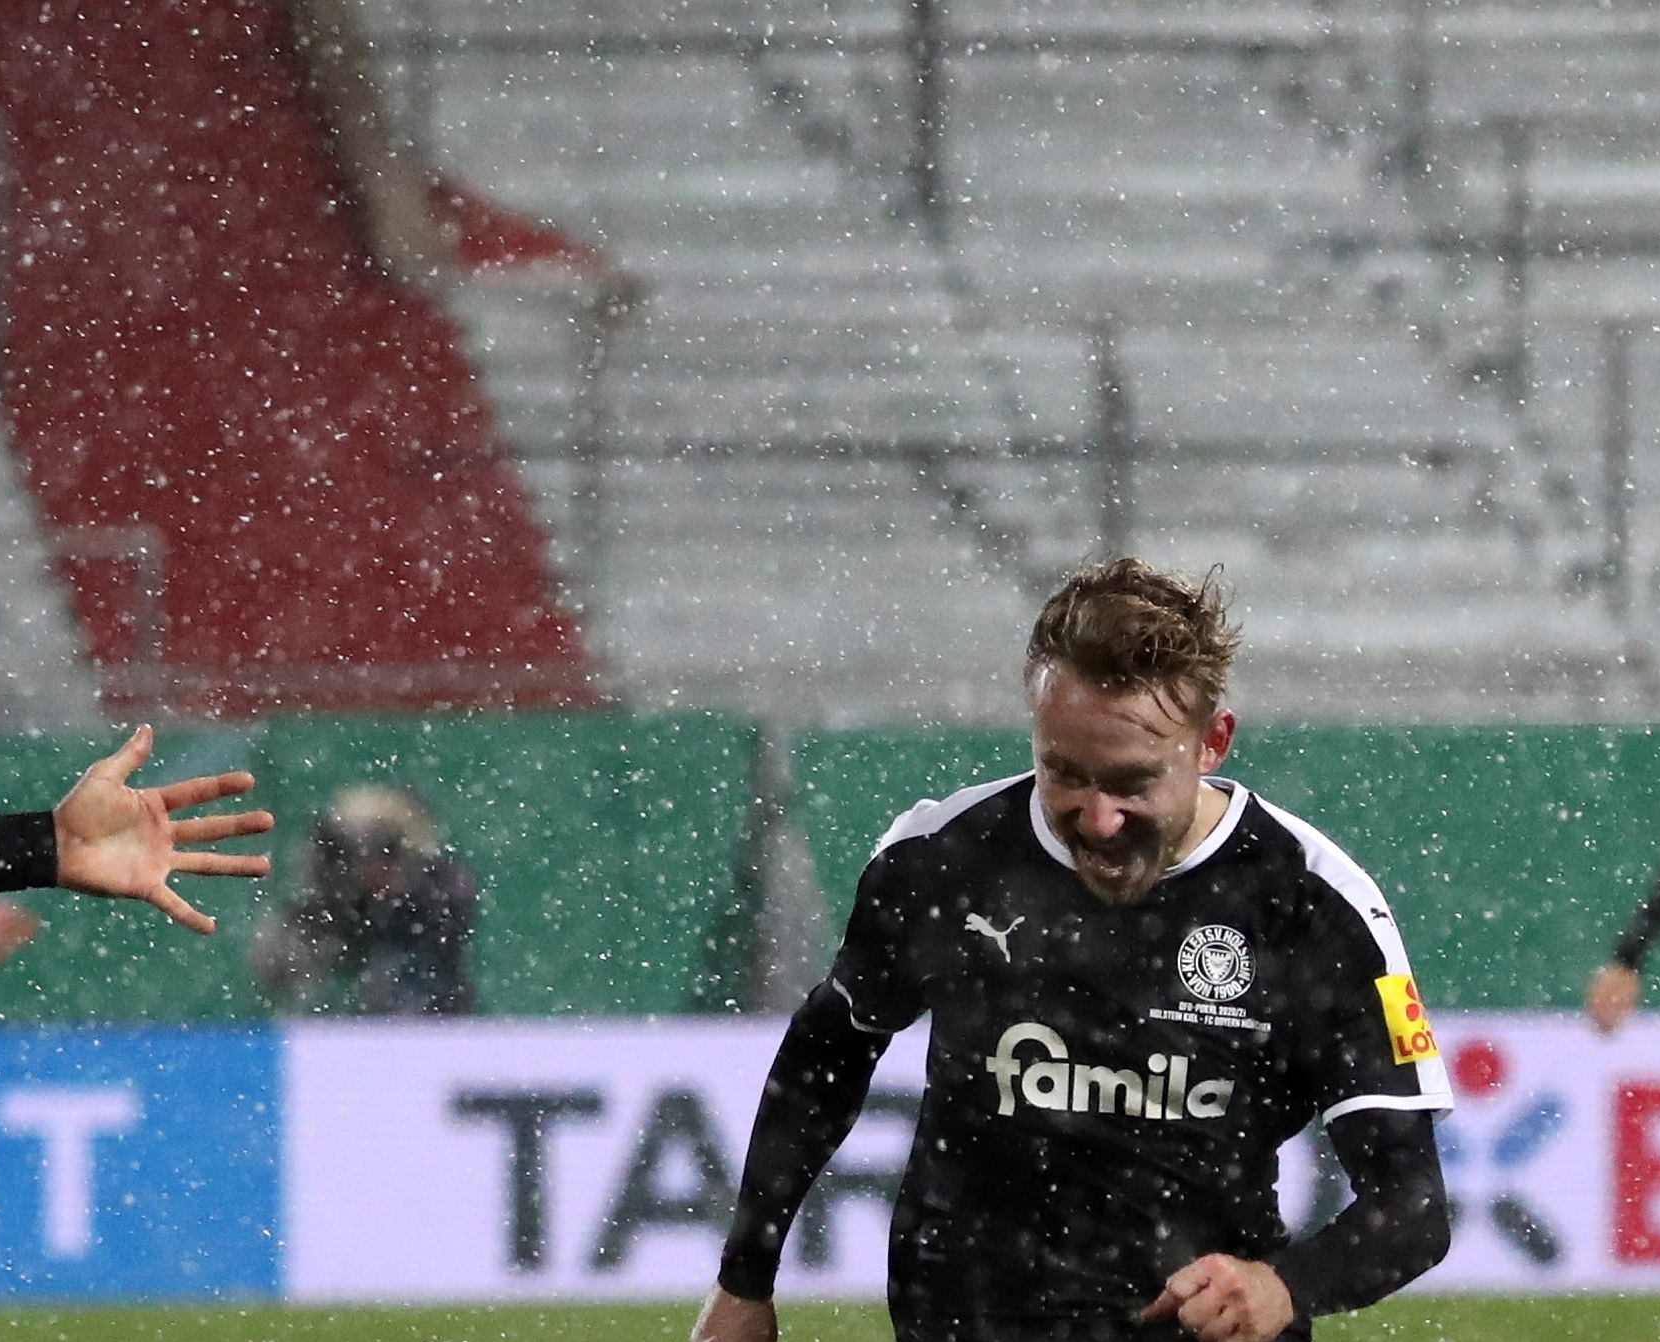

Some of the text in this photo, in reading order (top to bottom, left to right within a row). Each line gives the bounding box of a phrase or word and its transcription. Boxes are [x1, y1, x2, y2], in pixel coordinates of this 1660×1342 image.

[1188, 973, 1243, 999] VON 1900
[986, 1022, 1236, 1121] famila
